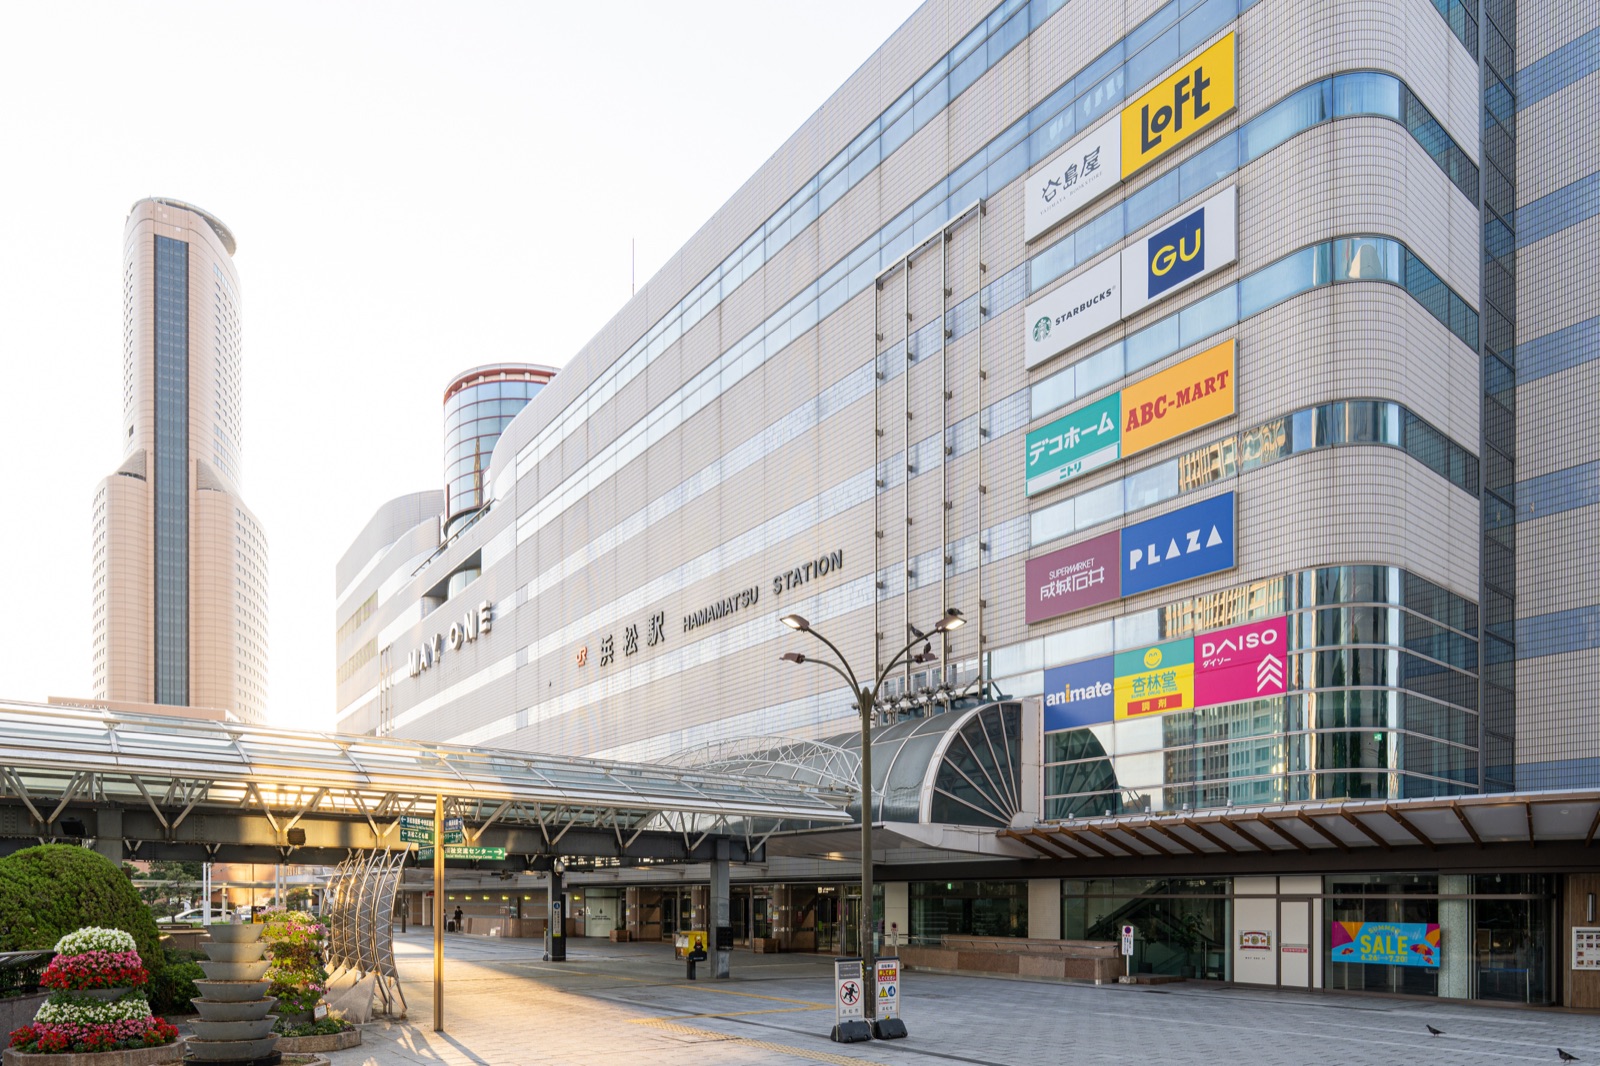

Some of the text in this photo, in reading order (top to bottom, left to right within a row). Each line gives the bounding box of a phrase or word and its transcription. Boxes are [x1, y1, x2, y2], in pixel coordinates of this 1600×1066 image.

[1042, 145, 1101, 203] 谷島屋
[1151, 228, 1201, 277] GU
[1055, 287, 1112, 326] STARBUCKS
[1125, 369, 1229, 433] ABC-MART
[1029, 411, 1115, 467] デコホーム
[1059, 461, 1082, 480] ニトリ
[1129, 524, 1223, 571] PLAZA
[1040, 566, 1105, 602] 成城石井
[1048, 557, 1095, 581] SUPERMARKET
[683, 549, 843, 633] HAMAMATSU STATION
[407, 600, 492, 678] MAY ONE
[600, 611, 665, 667] 浜松駅
[1202, 629, 1278, 658] DAISO
[1131, 670, 1177, 694] 杏林堂
[1202, 657, 1232, 669] ダイソー
[1046, 681, 1112, 707] animate
[1360, 935, 1408, 955] SALE
